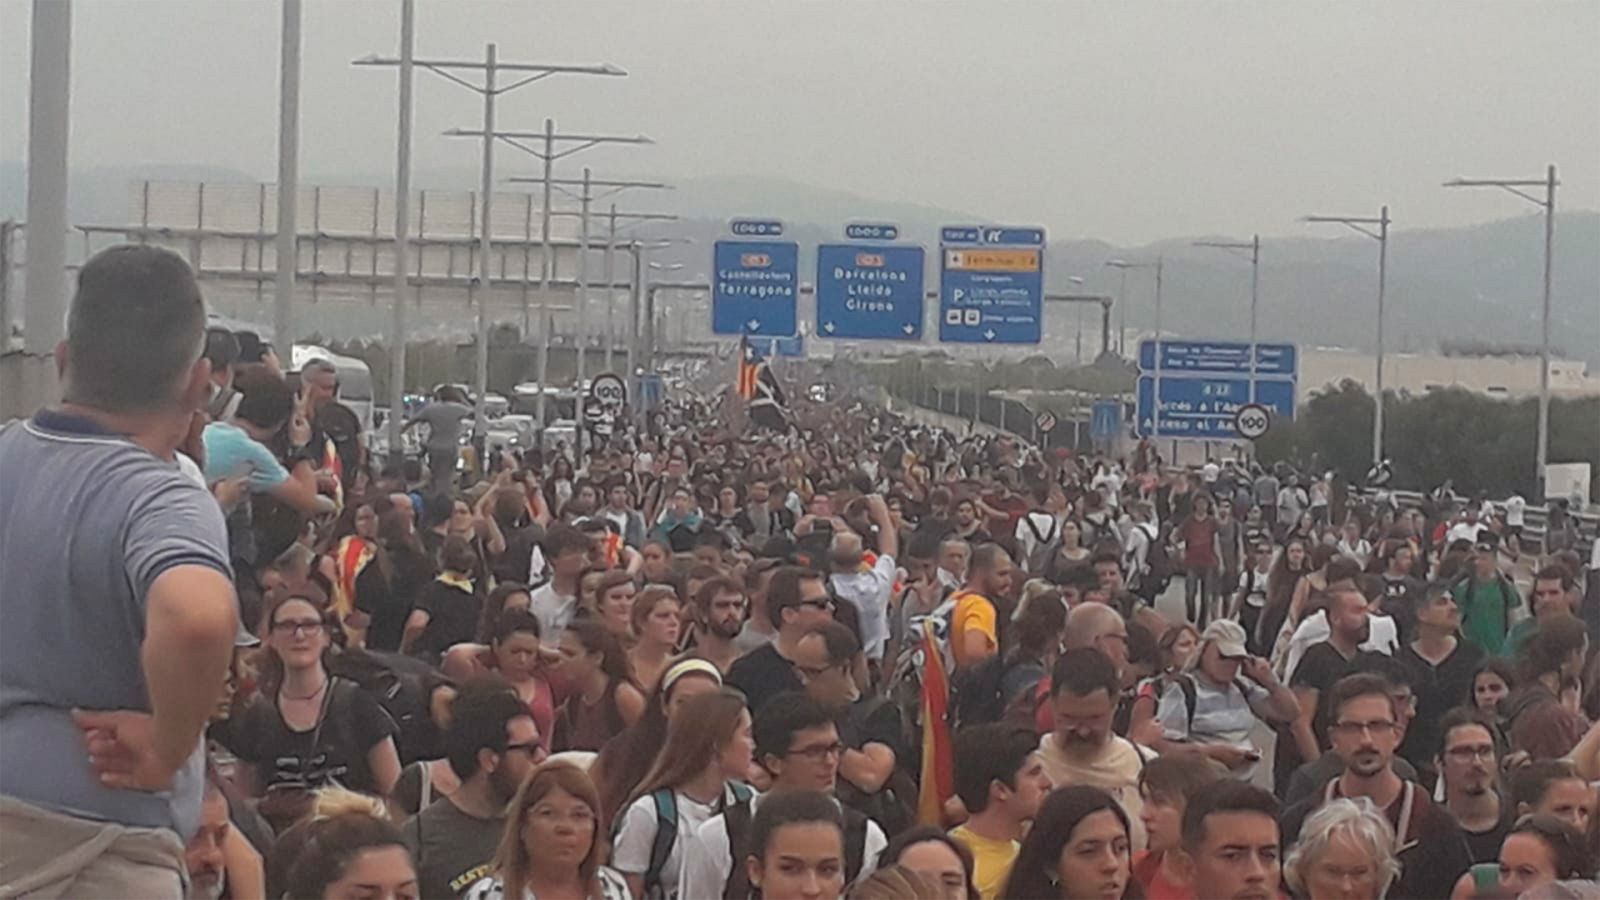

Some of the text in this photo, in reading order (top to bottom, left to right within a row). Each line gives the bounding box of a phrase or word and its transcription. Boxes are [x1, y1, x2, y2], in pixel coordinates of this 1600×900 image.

[848, 226, 880, 237] 1000
[834, 267, 906, 281] Barcelona
[719, 282, 792, 298] Tarragona
[847, 283, 892, 296] Lleida
[846, 299, 894, 311] Girona
[597, 386, 621, 399] 100
[1240, 416, 1265, 429] 100
